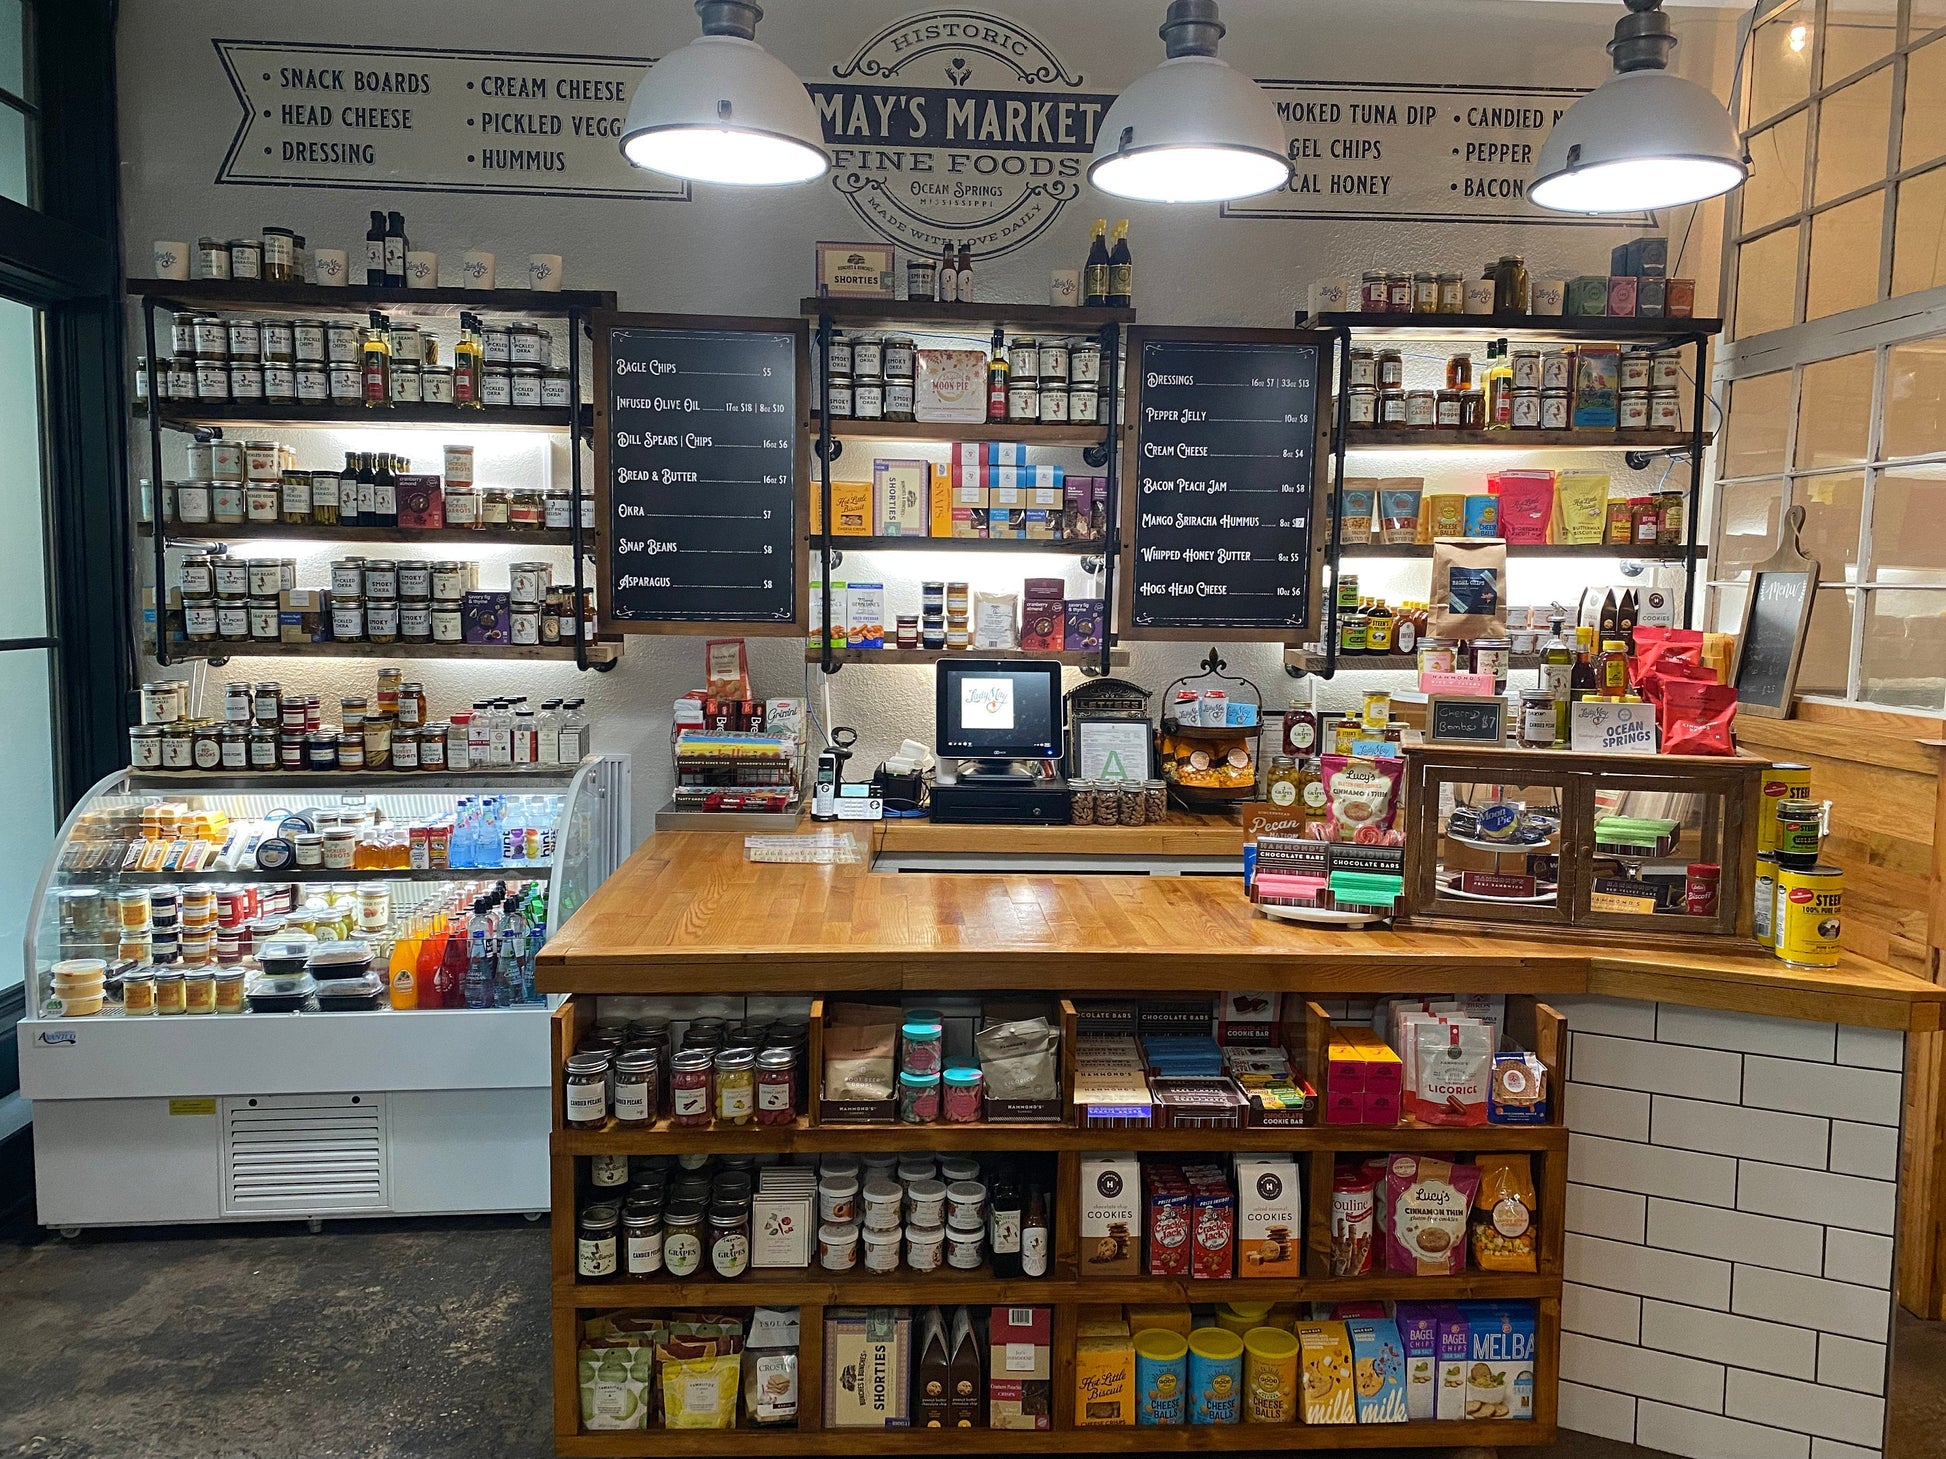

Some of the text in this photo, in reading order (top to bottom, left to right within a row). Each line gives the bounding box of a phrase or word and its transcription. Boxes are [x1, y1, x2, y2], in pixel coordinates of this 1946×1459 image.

[891, 24, 1028, 56] HISTORIC
[280, 68, 430, 94] SNACK BOARDS
[481, 76, 625, 102] CREAM CHEESE
[282, 105, 413, 130] HEAD CHEESE
[814, 93, 1101, 144] MAY'S MARKET
[1275, 101, 1437, 126] MOKED TUNA DIP
[1467, 107, 1544, 128] CANDIED
[481, 113, 626, 137] PICKLED VEGG
[282, 142, 375, 164] DRESSING
[1289, 138, 1381, 160] GEL CHIPS
[1465, 142, 1531, 163] PEPPER
[481, 149, 566, 171] HUMMUS
[832, 150, 1081, 177] FINE FOODS
[1288, 173, 1391, 196] CAL HONEY
[1464, 177, 1524, 198] BACON
[920, 198, 994, 208] MISSISSIPPI
[868, 196, 1042, 247] MADE WITH LOVE DAILY
[834, 274, 879, 285] SHORTIES
[763, 368, 772, 377] $5
[932, 381, 969, 391] MOON PIE
[1266, 378, 1275, 388] $7
[1298, 379, 1309, 388] $13
[740, 403, 752, 413] $18
[772, 404, 784, 413] $10
[1299, 414, 1308, 424] $8
[778, 440, 788, 449] $6
[1295, 449, 1303, 459] $4
[652, 471, 659, 481] &
[778, 475, 787, 485] $7
[1296, 484, 1305, 494] $8
[888, 477, 896, 521] SHORTIES
[763, 510, 771, 519] $7
[763, 545, 772, 554] $8
[1290, 553, 1299, 562] $5
[763, 579, 773, 589] $8
[1765, 581, 1800, 600] Menu
[1292, 587, 1300, 596] $6
[1432, 674, 1482, 682] HAMMOND'S
[965, 688, 989, 703] Lady
[1079, 699, 1140, 709] LETTERS
[1481, 714, 1496, 729] $7
[1606, 721, 1644, 737] OCEAN
[1602, 731, 1651, 748] SPRINGS
[1100, 750, 1128, 779] A
[1346, 769, 1376, 783] Lucy's
[1479, 808, 1505, 823] Moon
[1497, 815, 1513, 826] Pie
[1250, 816, 1300, 834] Pecan
[503, 830, 511, 858] hint
[1259, 843, 1326, 852] HAMMOND'S
[1260, 851, 1303, 860] CHOCOLATE
[1333, 859, 1400, 869] CHOCOLATE BARS
[1688, 892, 1711, 900] Biscoff
[1803, 905, 1819, 914] 100%
[1428, 1084, 1478, 1095] LICORICE
[1416, 1188, 1450, 1202] Lucy's
[1087, 1211, 1133, 1219] COOKIES
[1247, 1213, 1293, 1222] COOKIES
[1405, 1207, 1443, 1216] CINNAMON
[1155, 1220, 1189, 1240] Cracker Jack
[668, 1248, 696, 1257] GRAPES
[1410, 1329, 1435, 1340] BAGEL
[1442, 1333, 1467, 1344] BAGEL
[1410, 1340, 1434, 1348] CHIPS
[1442, 1344, 1467, 1352] CHIPS
[1473, 1333, 1535, 1360] MELBA
[874, 1345, 886, 1411] SHORTIES
[1079, 1369, 1128, 1391] Hot Little
[1088, 1385, 1124, 1400] Biscuit
[1151, 1400, 1179, 1410] CHEESE
[1253, 1397, 1284, 1410] CHEESE
[1308, 1388, 1355, 1424] milk
[1361, 1387, 1406, 1423] milk
[1154, 1409, 1178, 1419] BALLS
[1255, 1408, 1281, 1419] BALLS
